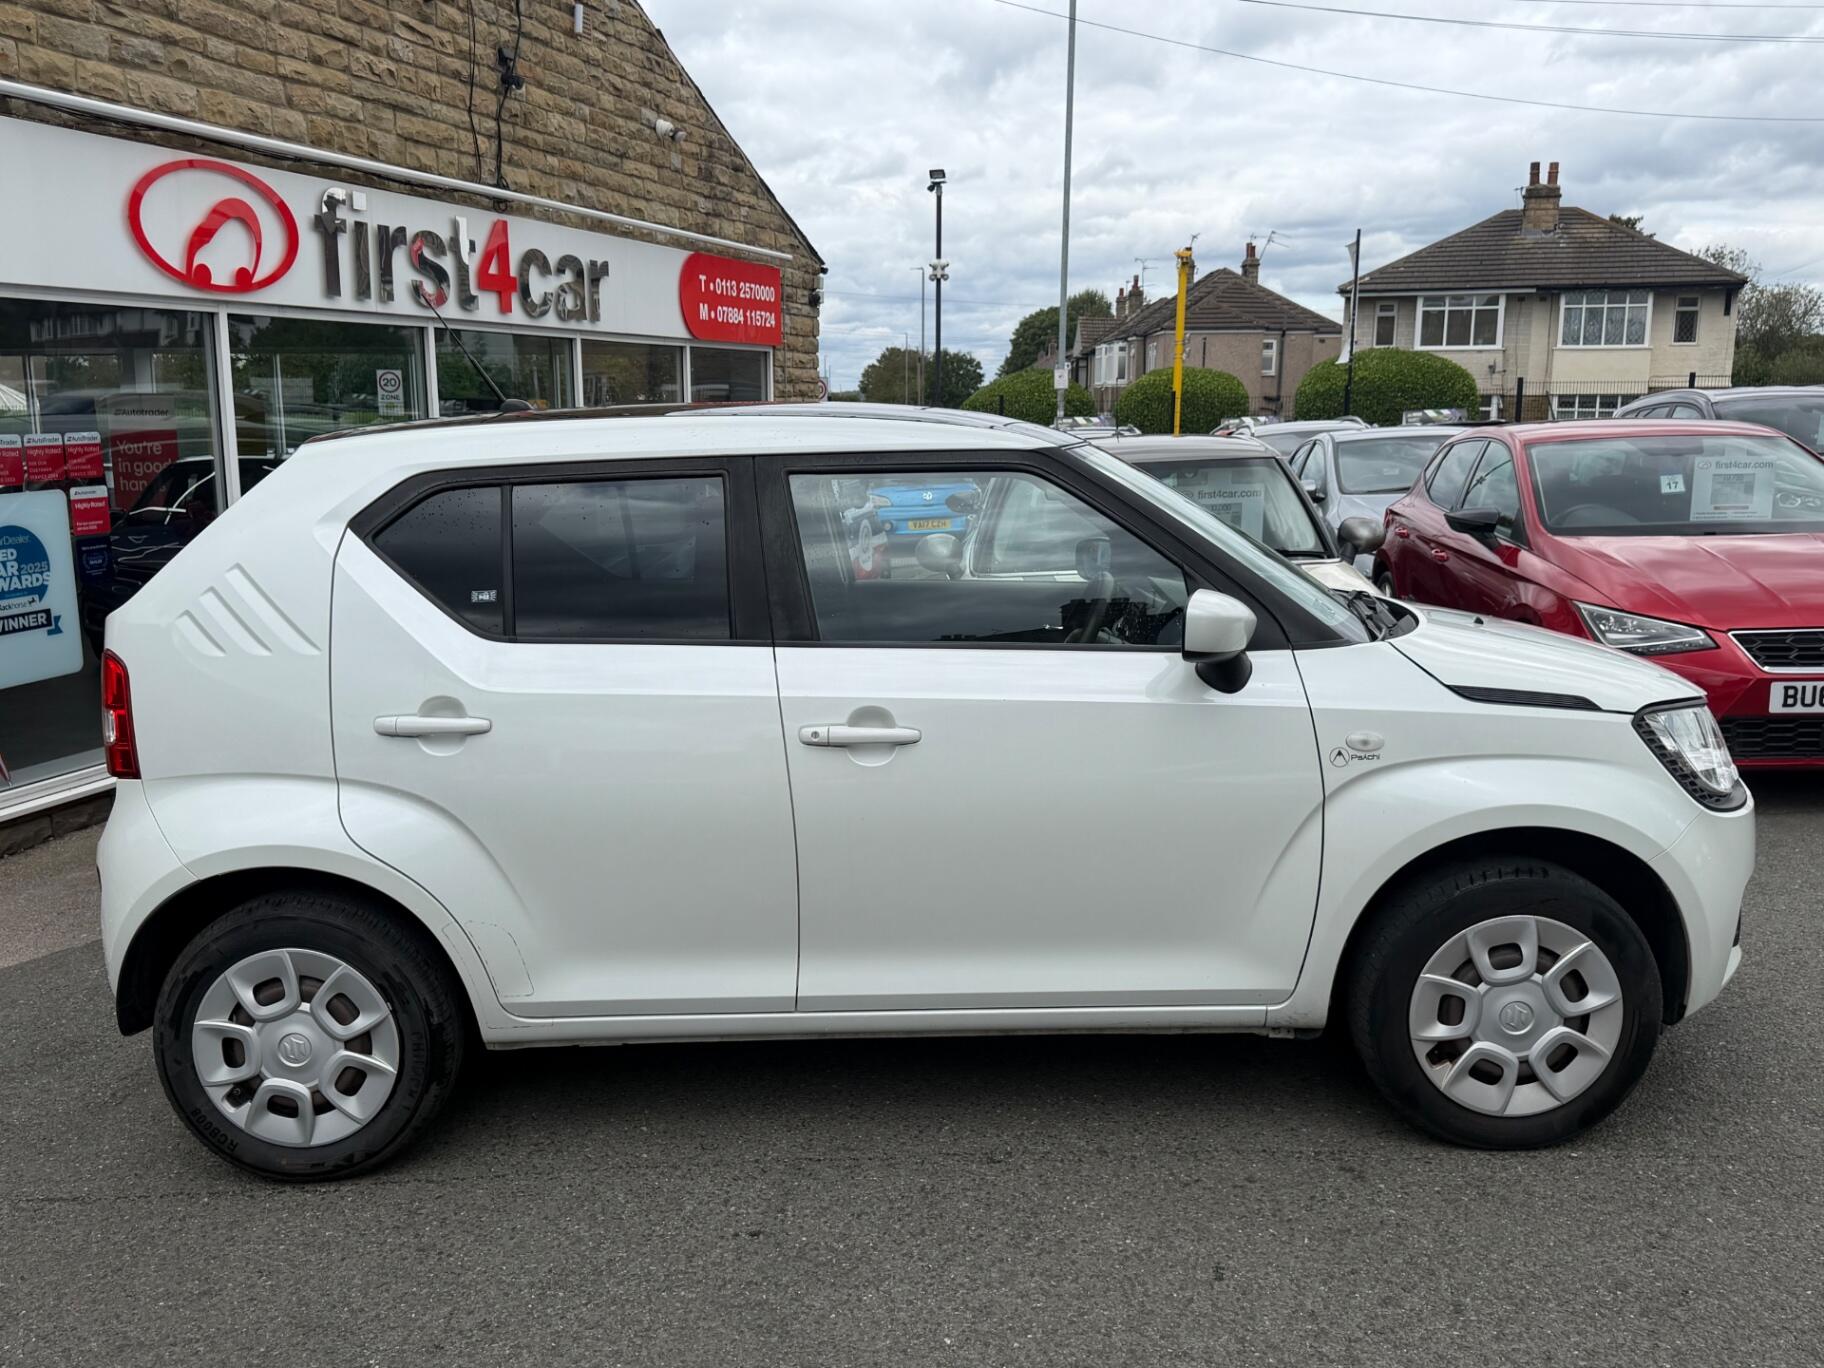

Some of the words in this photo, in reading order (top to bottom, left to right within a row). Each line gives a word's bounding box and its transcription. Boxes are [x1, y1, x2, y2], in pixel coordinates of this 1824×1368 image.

[313, 186, 610, 321] first4car
[699, 274, 707, 292] T
[715, 278, 737, 297] 0113
[739, 283, 776, 303] 2570000
[699, 303, 709, 321] M
[716, 305, 744, 325] 07884
[746, 309, 776, 329] 115724
[382, 377, 398, 388] 20
[116, 440, 163, 455] You're
[118, 459, 132, 473] in
[1715, 460, 1774, 470] first4car.com
[1666, 481, 1679, 490] 17
[1198, 490, 1261, 500] first4car.com
[20, 561, 49, 575] 2025
